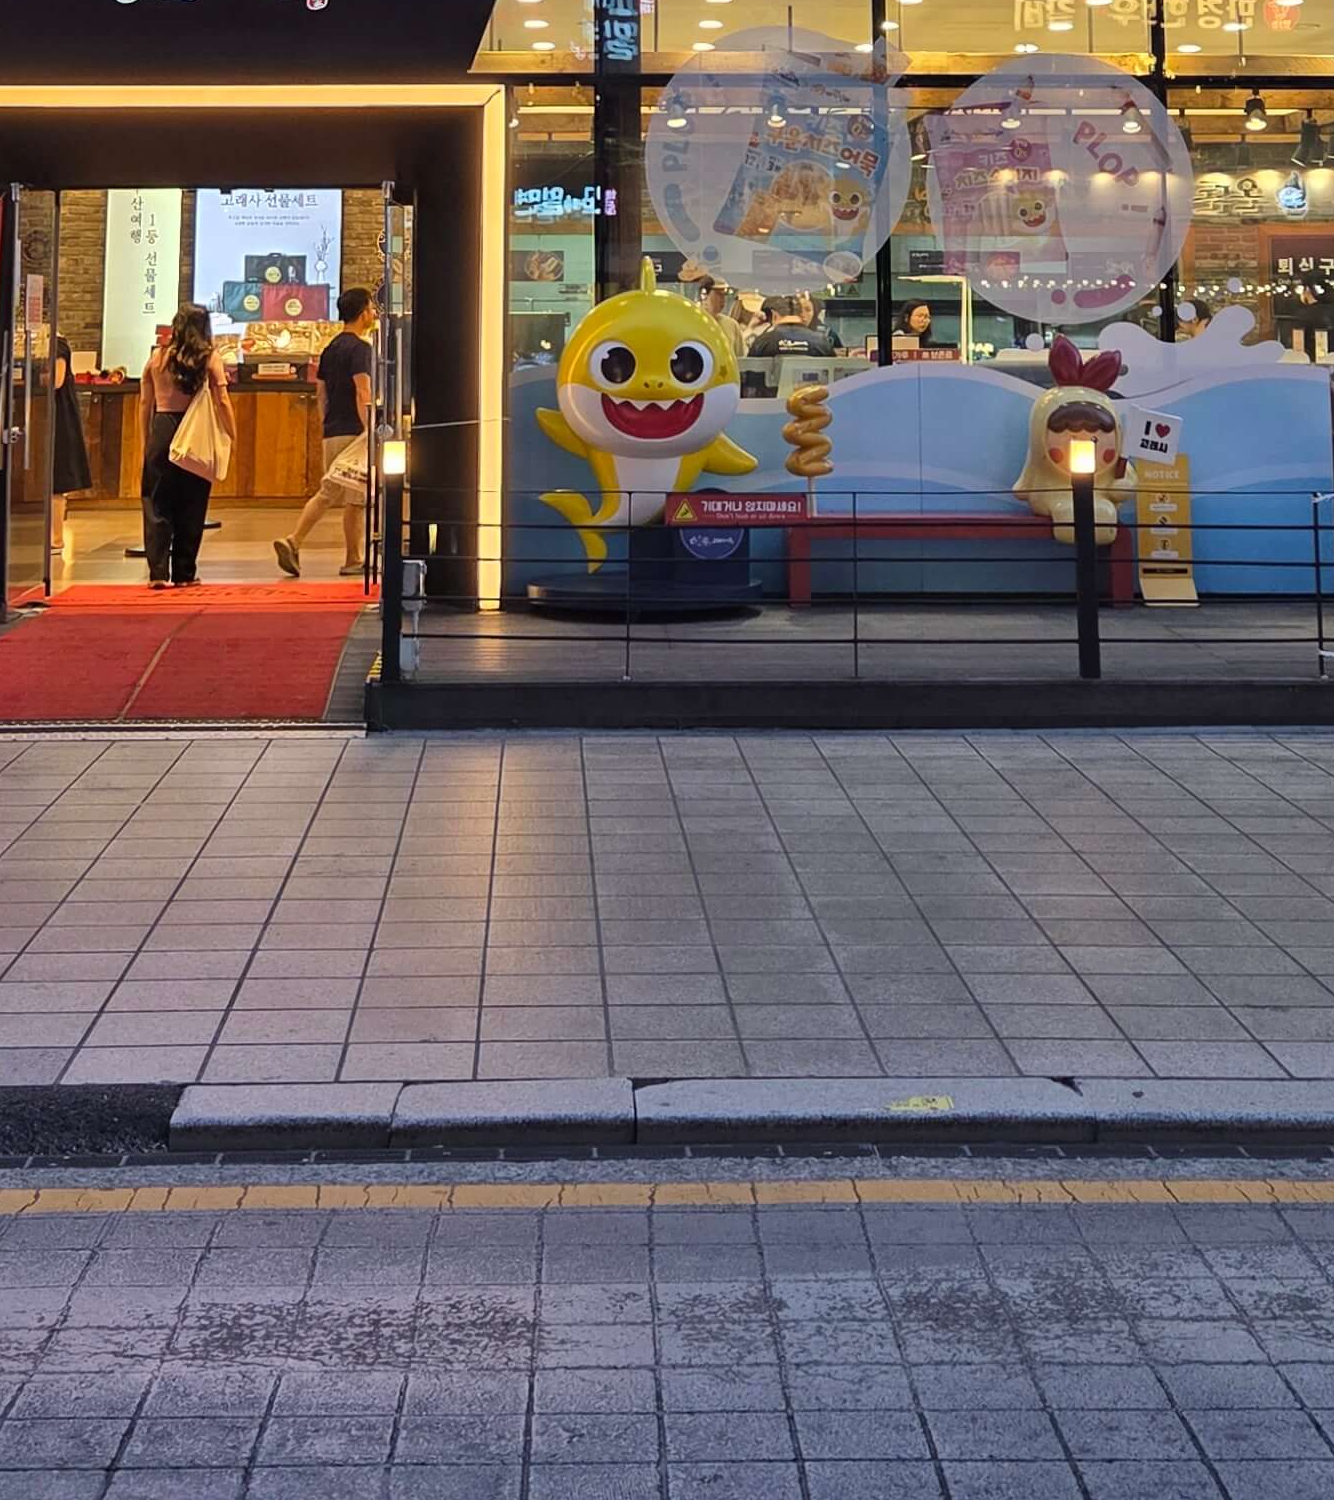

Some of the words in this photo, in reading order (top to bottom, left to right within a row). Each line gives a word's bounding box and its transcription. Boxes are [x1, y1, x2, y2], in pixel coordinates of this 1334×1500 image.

[1072, 120, 1140, 188] PLOP
[221, 192, 261, 209] 고래사
[265, 191, 319, 209] 선물세트
[130, 187, 144, 245] 산여행
[142, 251, 158, 315] 선물세트
[1144, 420, 1152, 436] I
[1145, 470, 1180, 480] NOTICE
[701, 501, 743, 513] 기대거나
